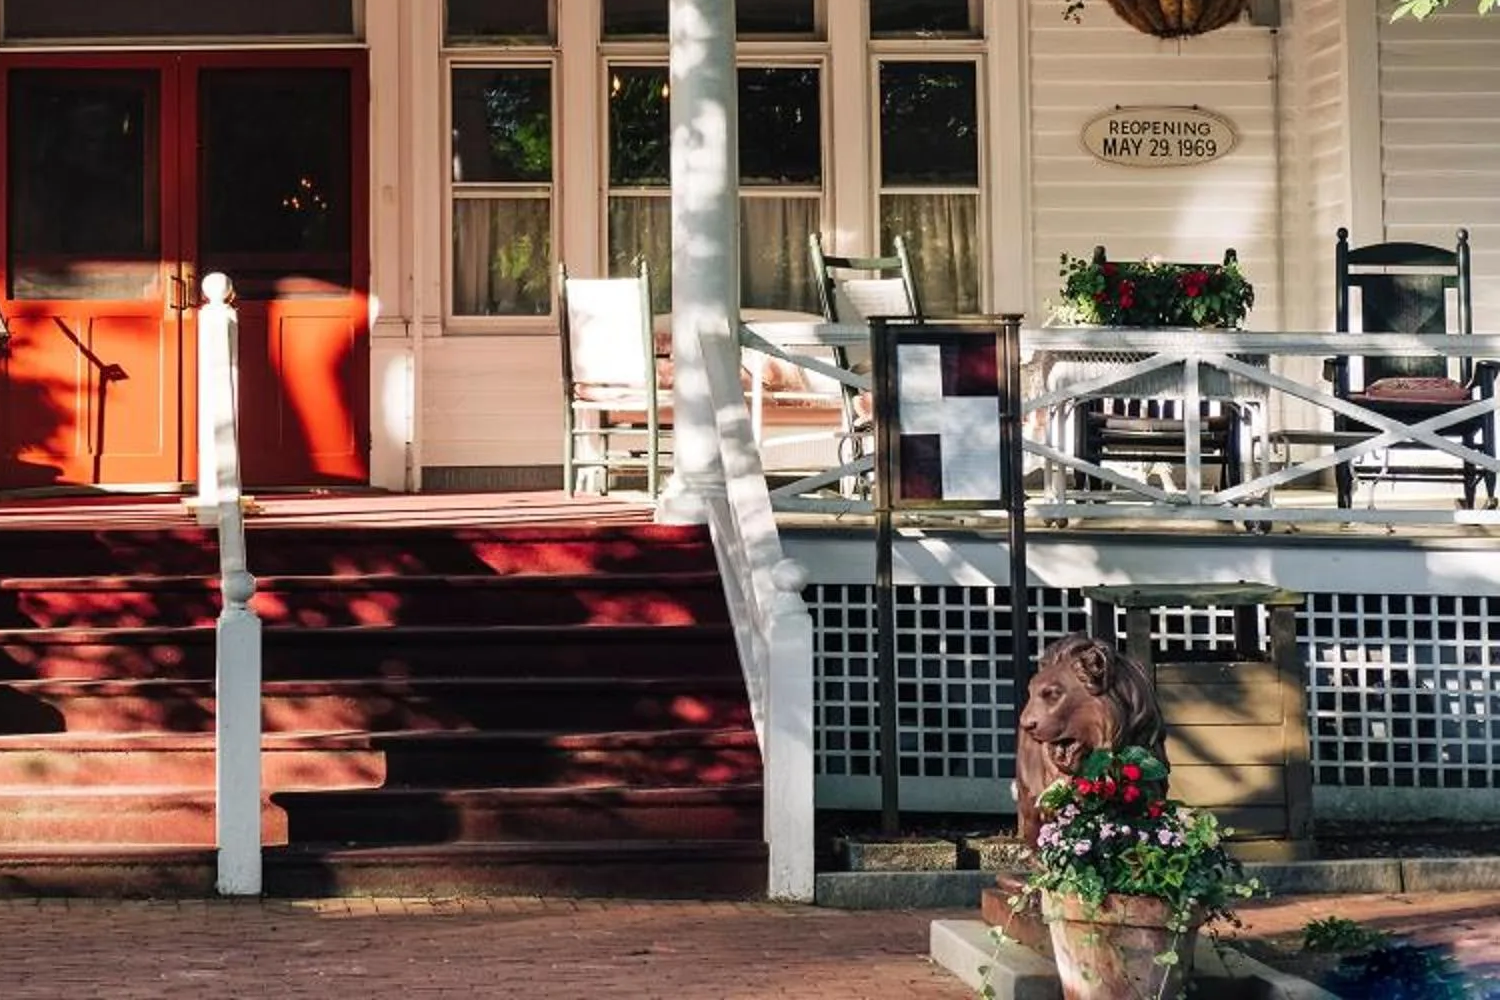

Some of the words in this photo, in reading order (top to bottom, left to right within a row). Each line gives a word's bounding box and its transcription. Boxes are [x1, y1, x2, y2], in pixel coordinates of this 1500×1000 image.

[1109, 120, 1211, 137] REOPENING
[1102, 138, 1143, 156] MAY
[1177, 138, 1217, 157] 1969
